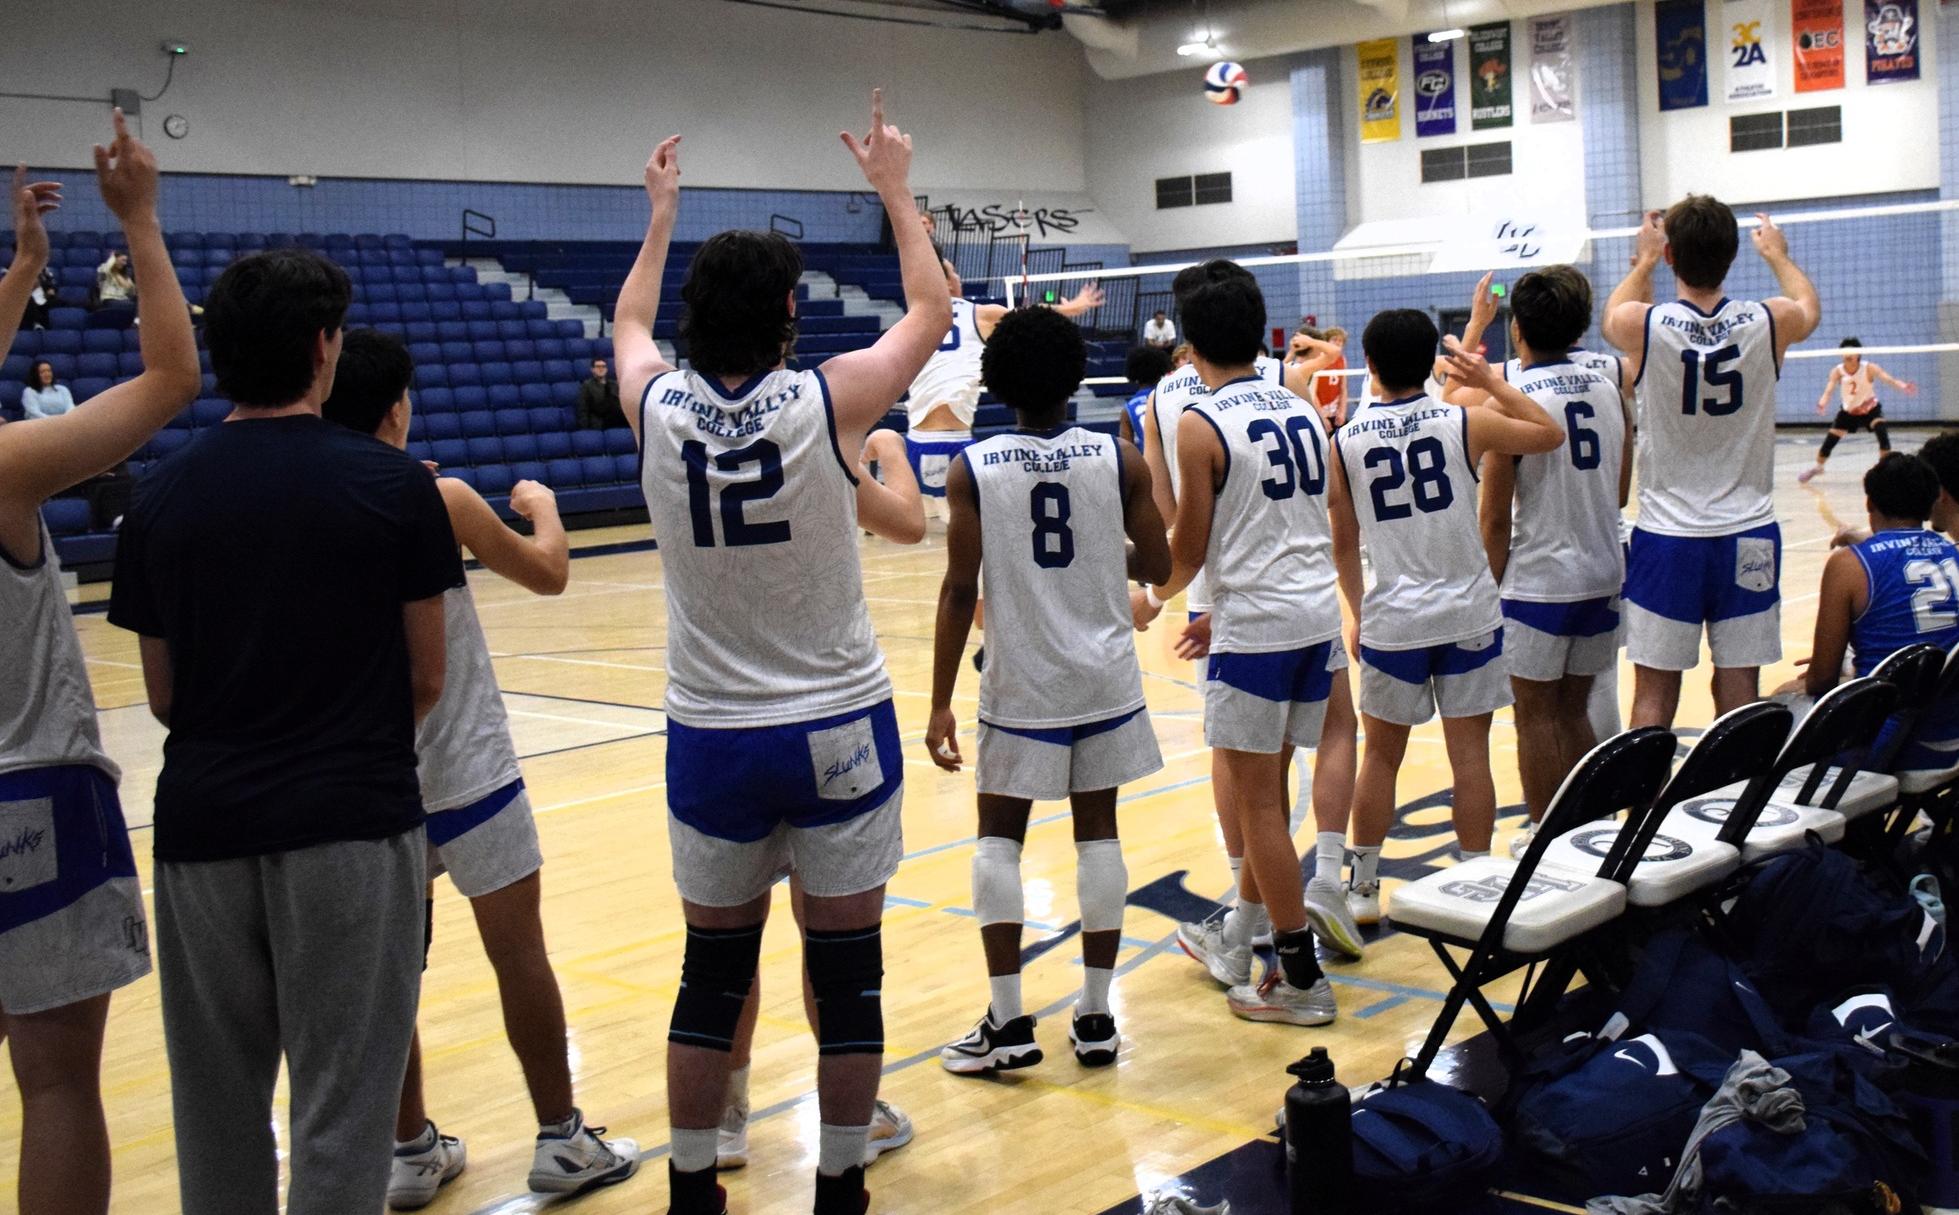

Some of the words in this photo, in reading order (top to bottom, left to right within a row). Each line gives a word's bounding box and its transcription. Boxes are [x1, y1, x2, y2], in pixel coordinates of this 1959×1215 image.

[1732, 42, 1766, 68] 2A
[944, 203, 1093, 238] LASERS
[1163, 375, 1202, 394] IRVIN
[1681, 344, 1743, 416] 15
[1214, 391, 1265, 412] IRVINE
[697, 416, 764, 438] COLLEGE
[1348, 418, 1395, 438] IRVINE
[1400, 408, 1450, 427] VALLEY
[1379, 423, 1421, 439] COLLEGE
[1564, 401, 1602, 471] 6
[983, 447, 1041, 466] IRVINE
[1247, 415, 1325, 501] 30
[681, 438, 792, 547] 12
[1364, 436, 1454, 522] 28
[1030, 481, 1074, 569] 8
[1870, 536, 1919, 553] IRVINE
